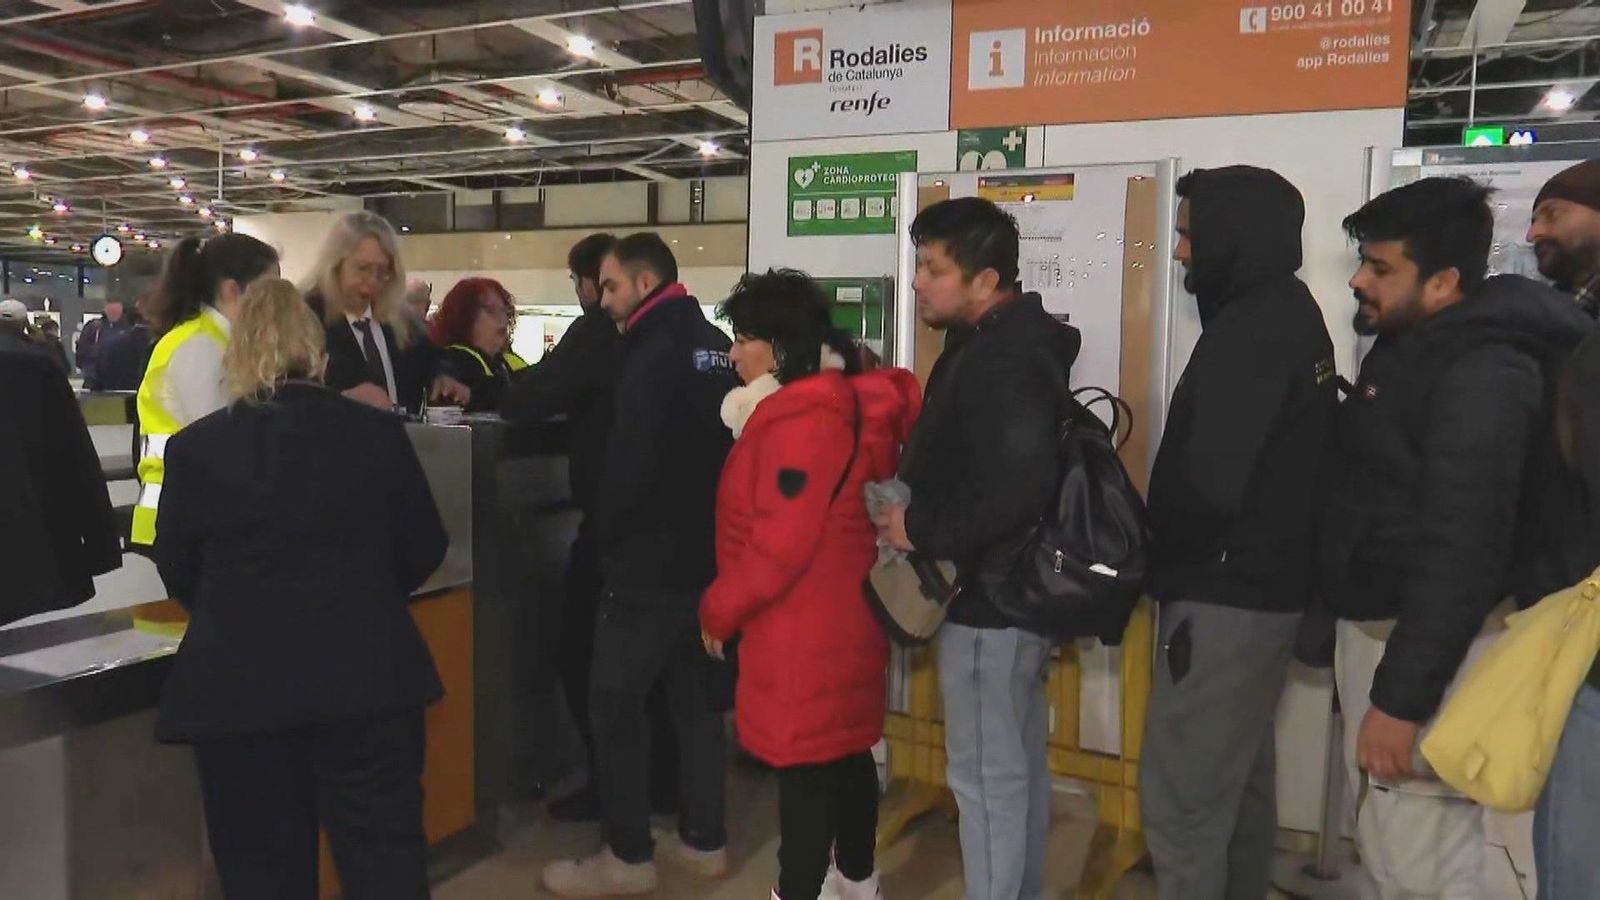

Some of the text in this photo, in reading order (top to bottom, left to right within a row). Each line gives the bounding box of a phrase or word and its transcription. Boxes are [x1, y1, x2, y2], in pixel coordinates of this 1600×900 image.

[1271, 0, 1393, 21] 900 41 00 41
[1035, 17, 1150, 44] Informació
[1320, 34, 1391, 49] @rodalies
[794, 37, 821, 72] R
[830, 44, 928, 69] Rodalies
[1297, 51, 1390, 69] app Rodalies
[828, 68, 903, 82] de Catalunya
[1034, 65, 1137, 87] Information
[830, 90, 891, 117] renfe
[824, 167, 849, 176] ZONA
